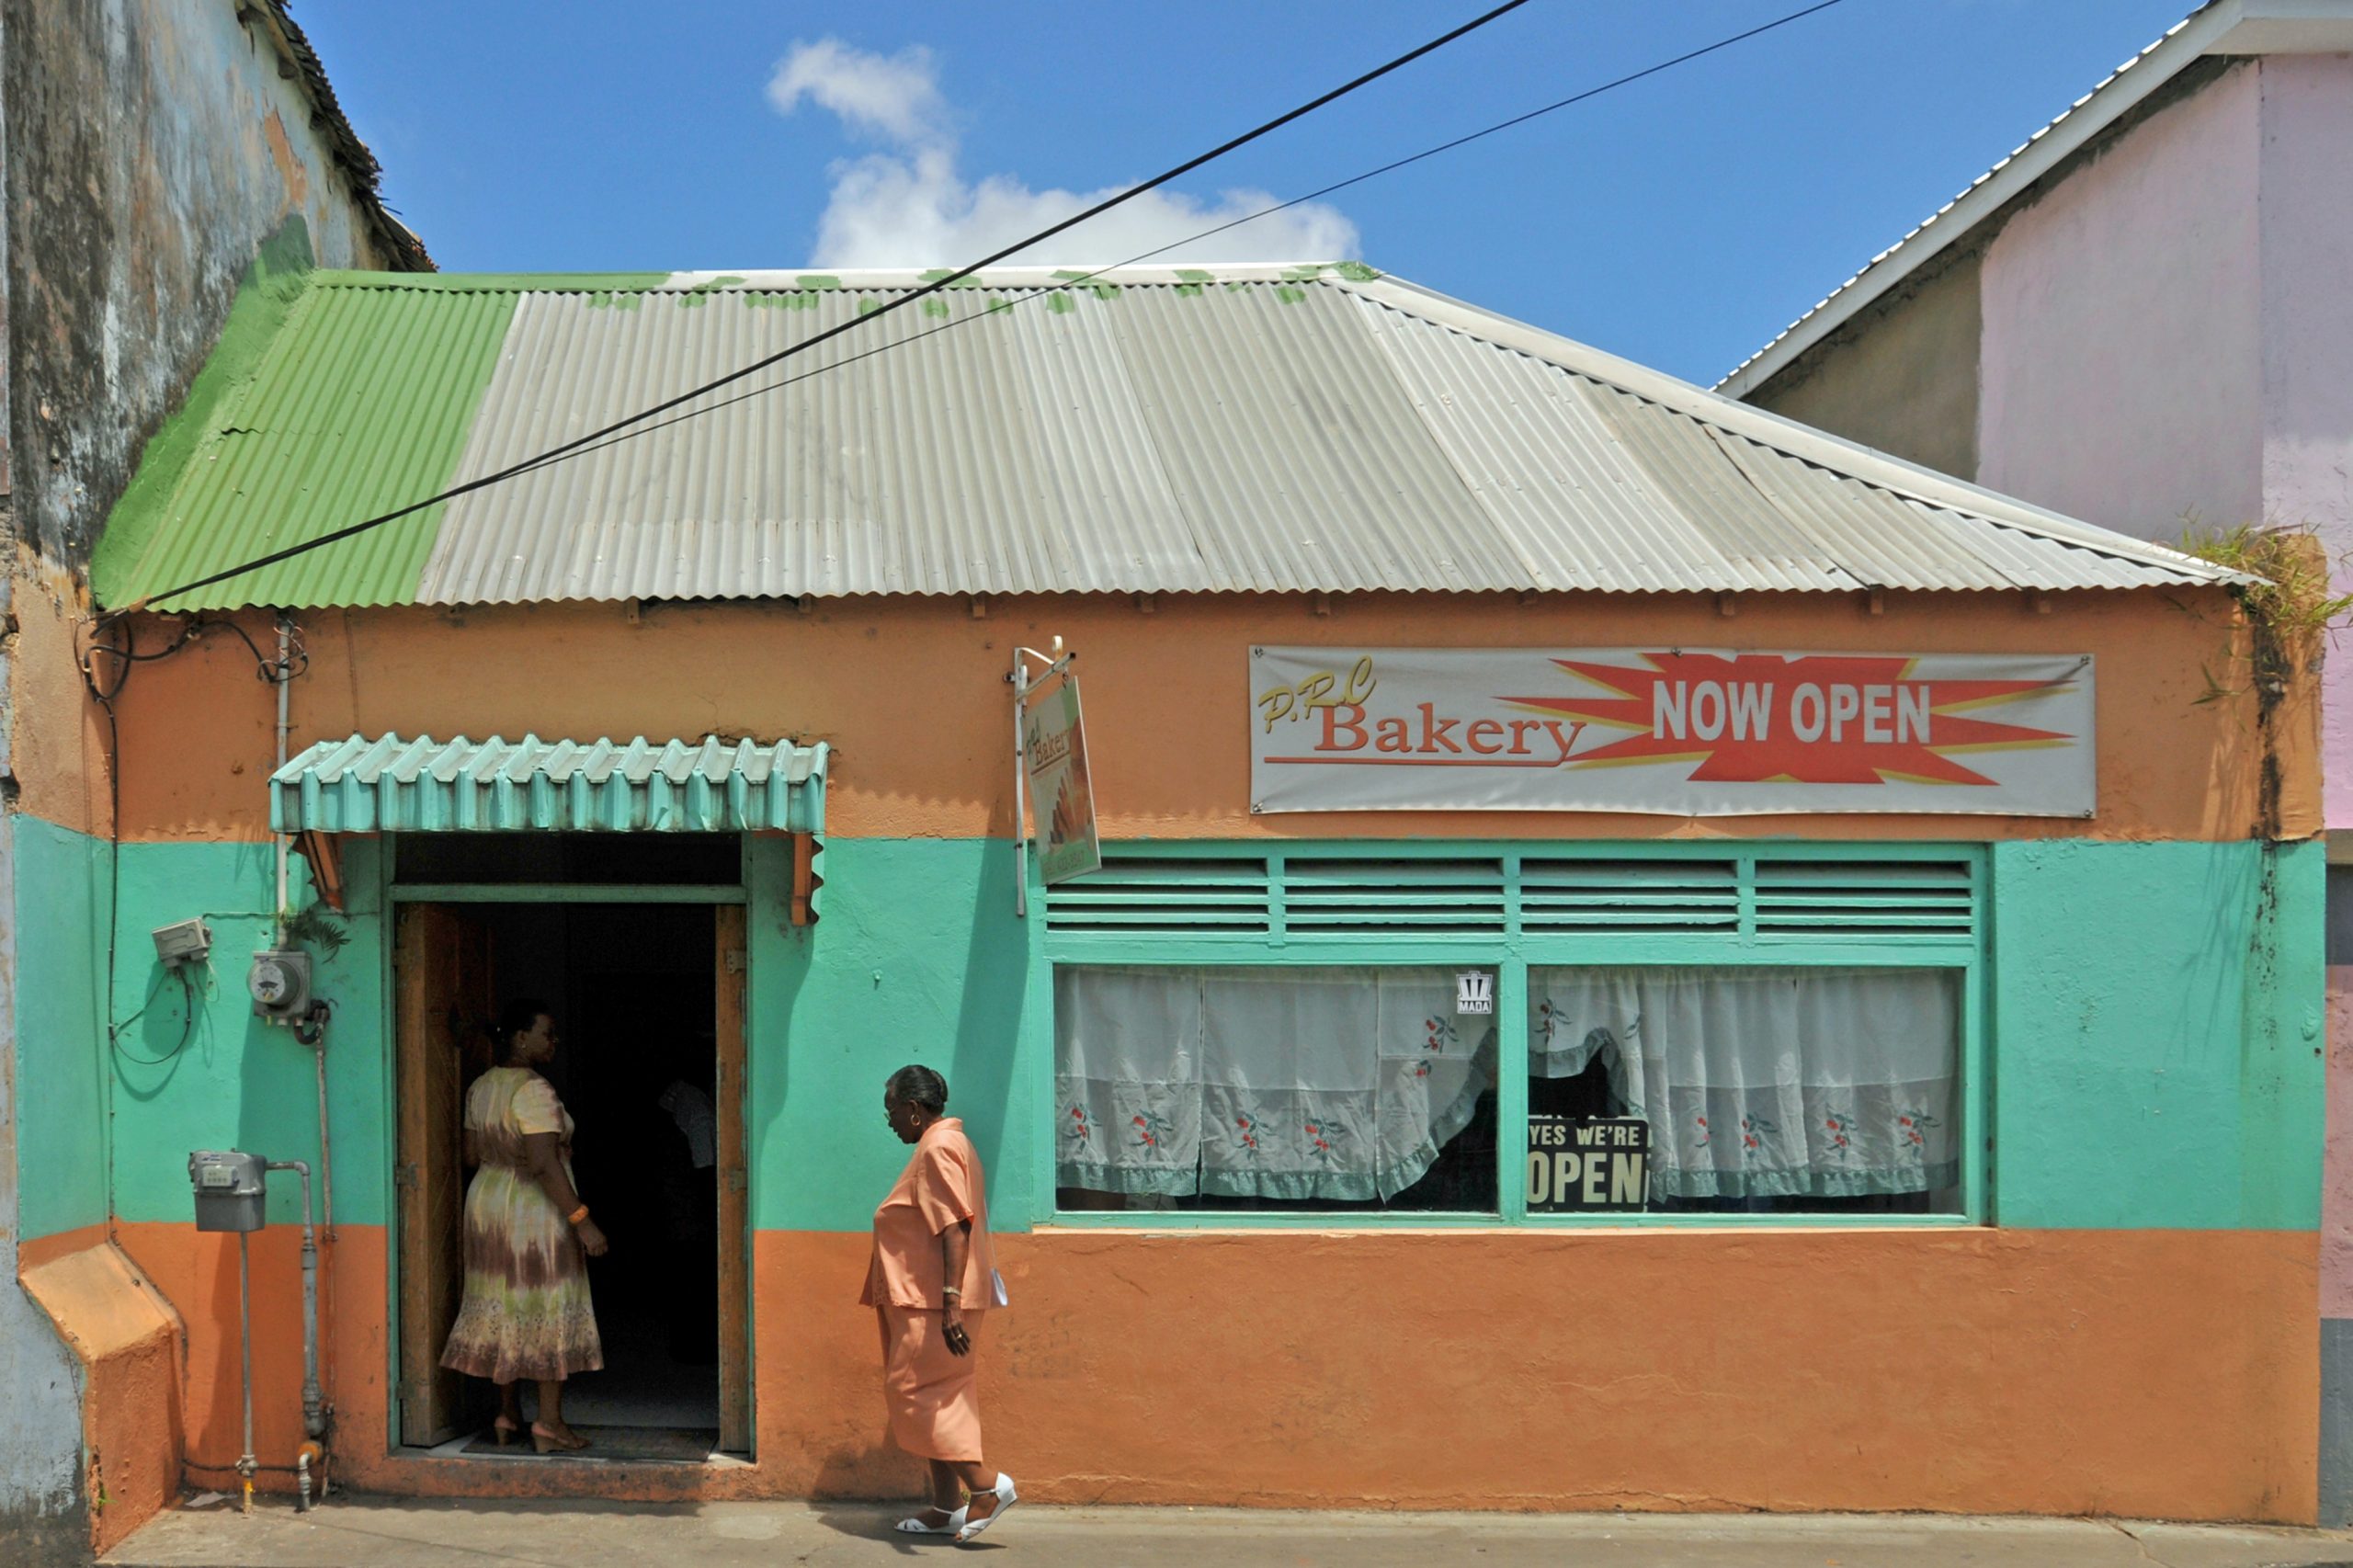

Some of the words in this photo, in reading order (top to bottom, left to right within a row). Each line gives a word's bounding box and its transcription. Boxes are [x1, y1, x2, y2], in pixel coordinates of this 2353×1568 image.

[1314, 702, 1587, 767] Bakery
[1654, 680, 1774, 742] NOW
[1790, 682, 1930, 744] OPEN
[1529, 1124, 1567, 1146] YES
[1576, 1125, 1641, 1147] WE'RE
[1528, 1150, 1643, 1204] OPEN
